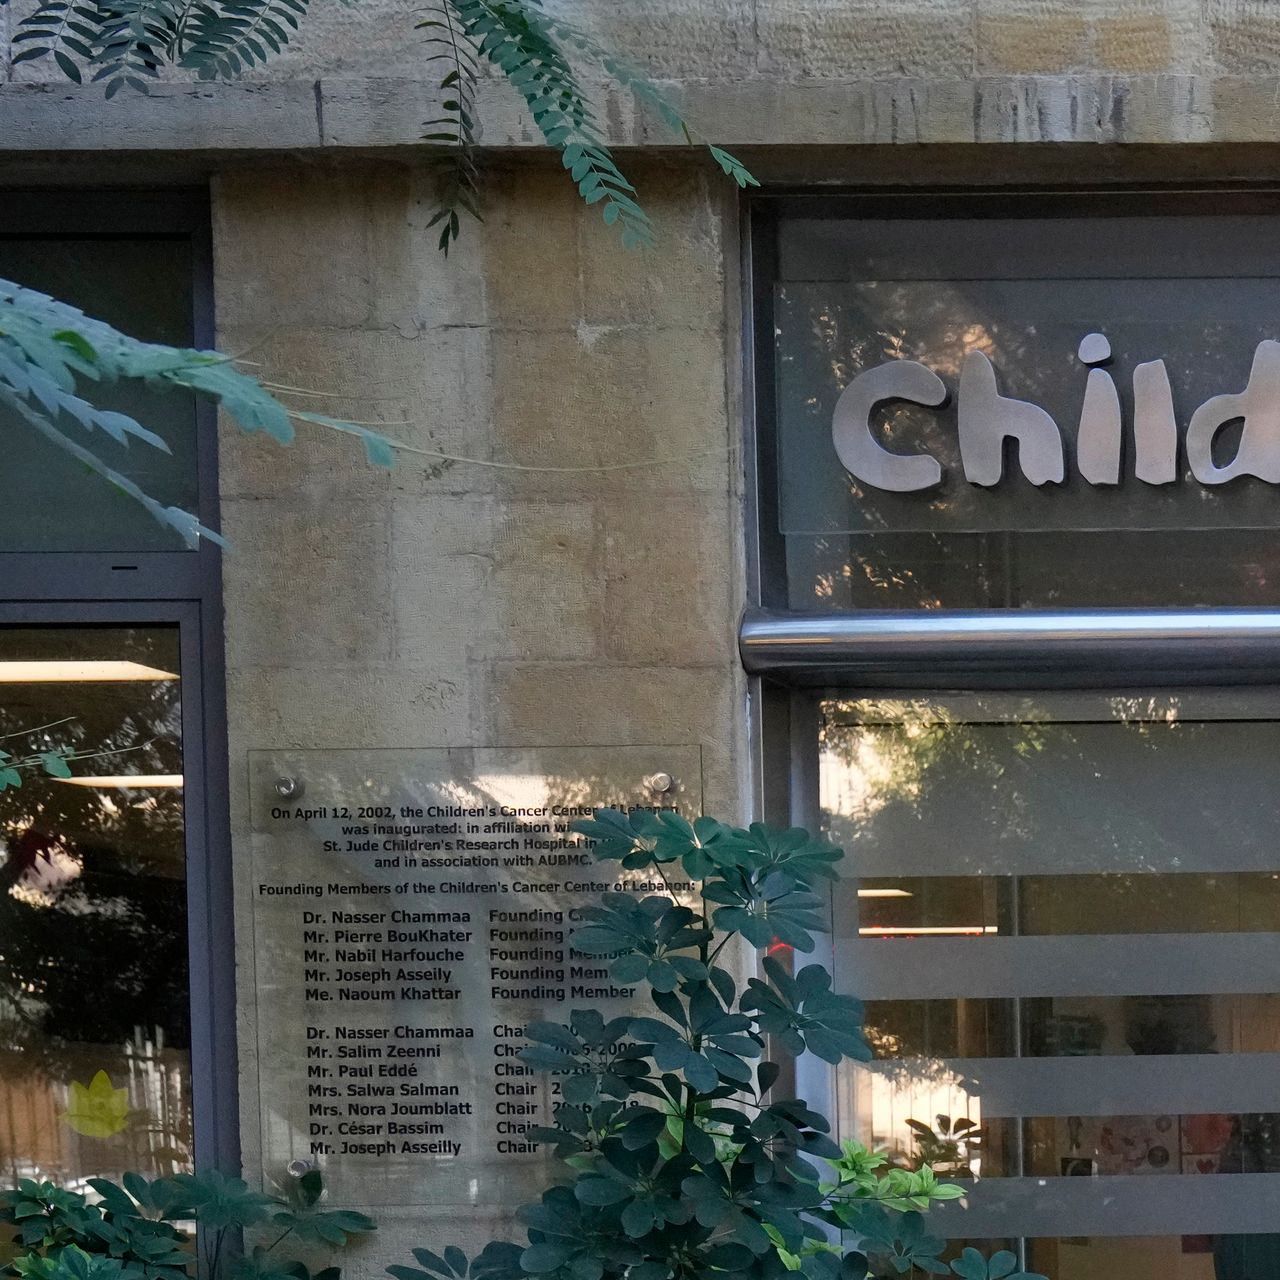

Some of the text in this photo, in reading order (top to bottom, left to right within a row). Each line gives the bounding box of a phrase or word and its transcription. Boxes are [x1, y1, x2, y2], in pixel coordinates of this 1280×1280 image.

[271, 807, 291, 819] On
[294, 807, 327, 821] April
[332, 807, 352, 821] 12,
[357, 807, 396, 820] 2002,
[400, 806, 424, 818] the
[426, 805, 496, 817] Children's
[500, 805, 548, 817] Cancer
[342, 821, 550, 837] was inaugurated: in affiliation
[322, 840, 342, 852] St.
[346, 840, 380, 852] Jude
[383, 839, 453, 851] Children's
[456, 838, 519, 851] Research
[524, 838, 581, 852] Hospital
[374, 854, 593, 868] and in association with AUBMC.
[258, 880, 695, 898] Founding Members of the Children's Cancer Center of Lebanon:
[302, 911, 327, 925] Dr.
[331, 911, 387, 924] Nasser
[390, 909, 471, 926] Chammaa
[489, 909, 563, 924] Founding
[303, 928, 564, 944] Mr. Pierre BouKhater Founding
[304, 947, 564, 963] Mr. Nabil Harfouche Founding
[304, 967, 565, 984] Mr. Joseph Asseily Founding
[305, 985, 636, 1002] Me. Naoum Khattar Founding Member
[306, 1024, 474, 1040] Dr. Nasser Chammaa
[307, 1043, 441, 1059] Mr. Salim Zeenni
[307, 1062, 418, 1079] Mr. Paul Eddé
[308, 1084, 342, 1098] Mrs.
[346, 1083, 395, 1097] Salwa
[399, 1082, 460, 1097] Salman
[495, 1082, 537, 1095] Chair
[308, 1103, 343, 1117] Mrs.
[347, 1103, 387, 1117] Nora
[390, 1101, 473, 1116] Joumblatt
[496, 1102, 538, 1115] Chair
[309, 1121, 444, 1136] Dr. César Bassim
[310, 1139, 540, 1157] Mr. Joseph Asseilly Chair
